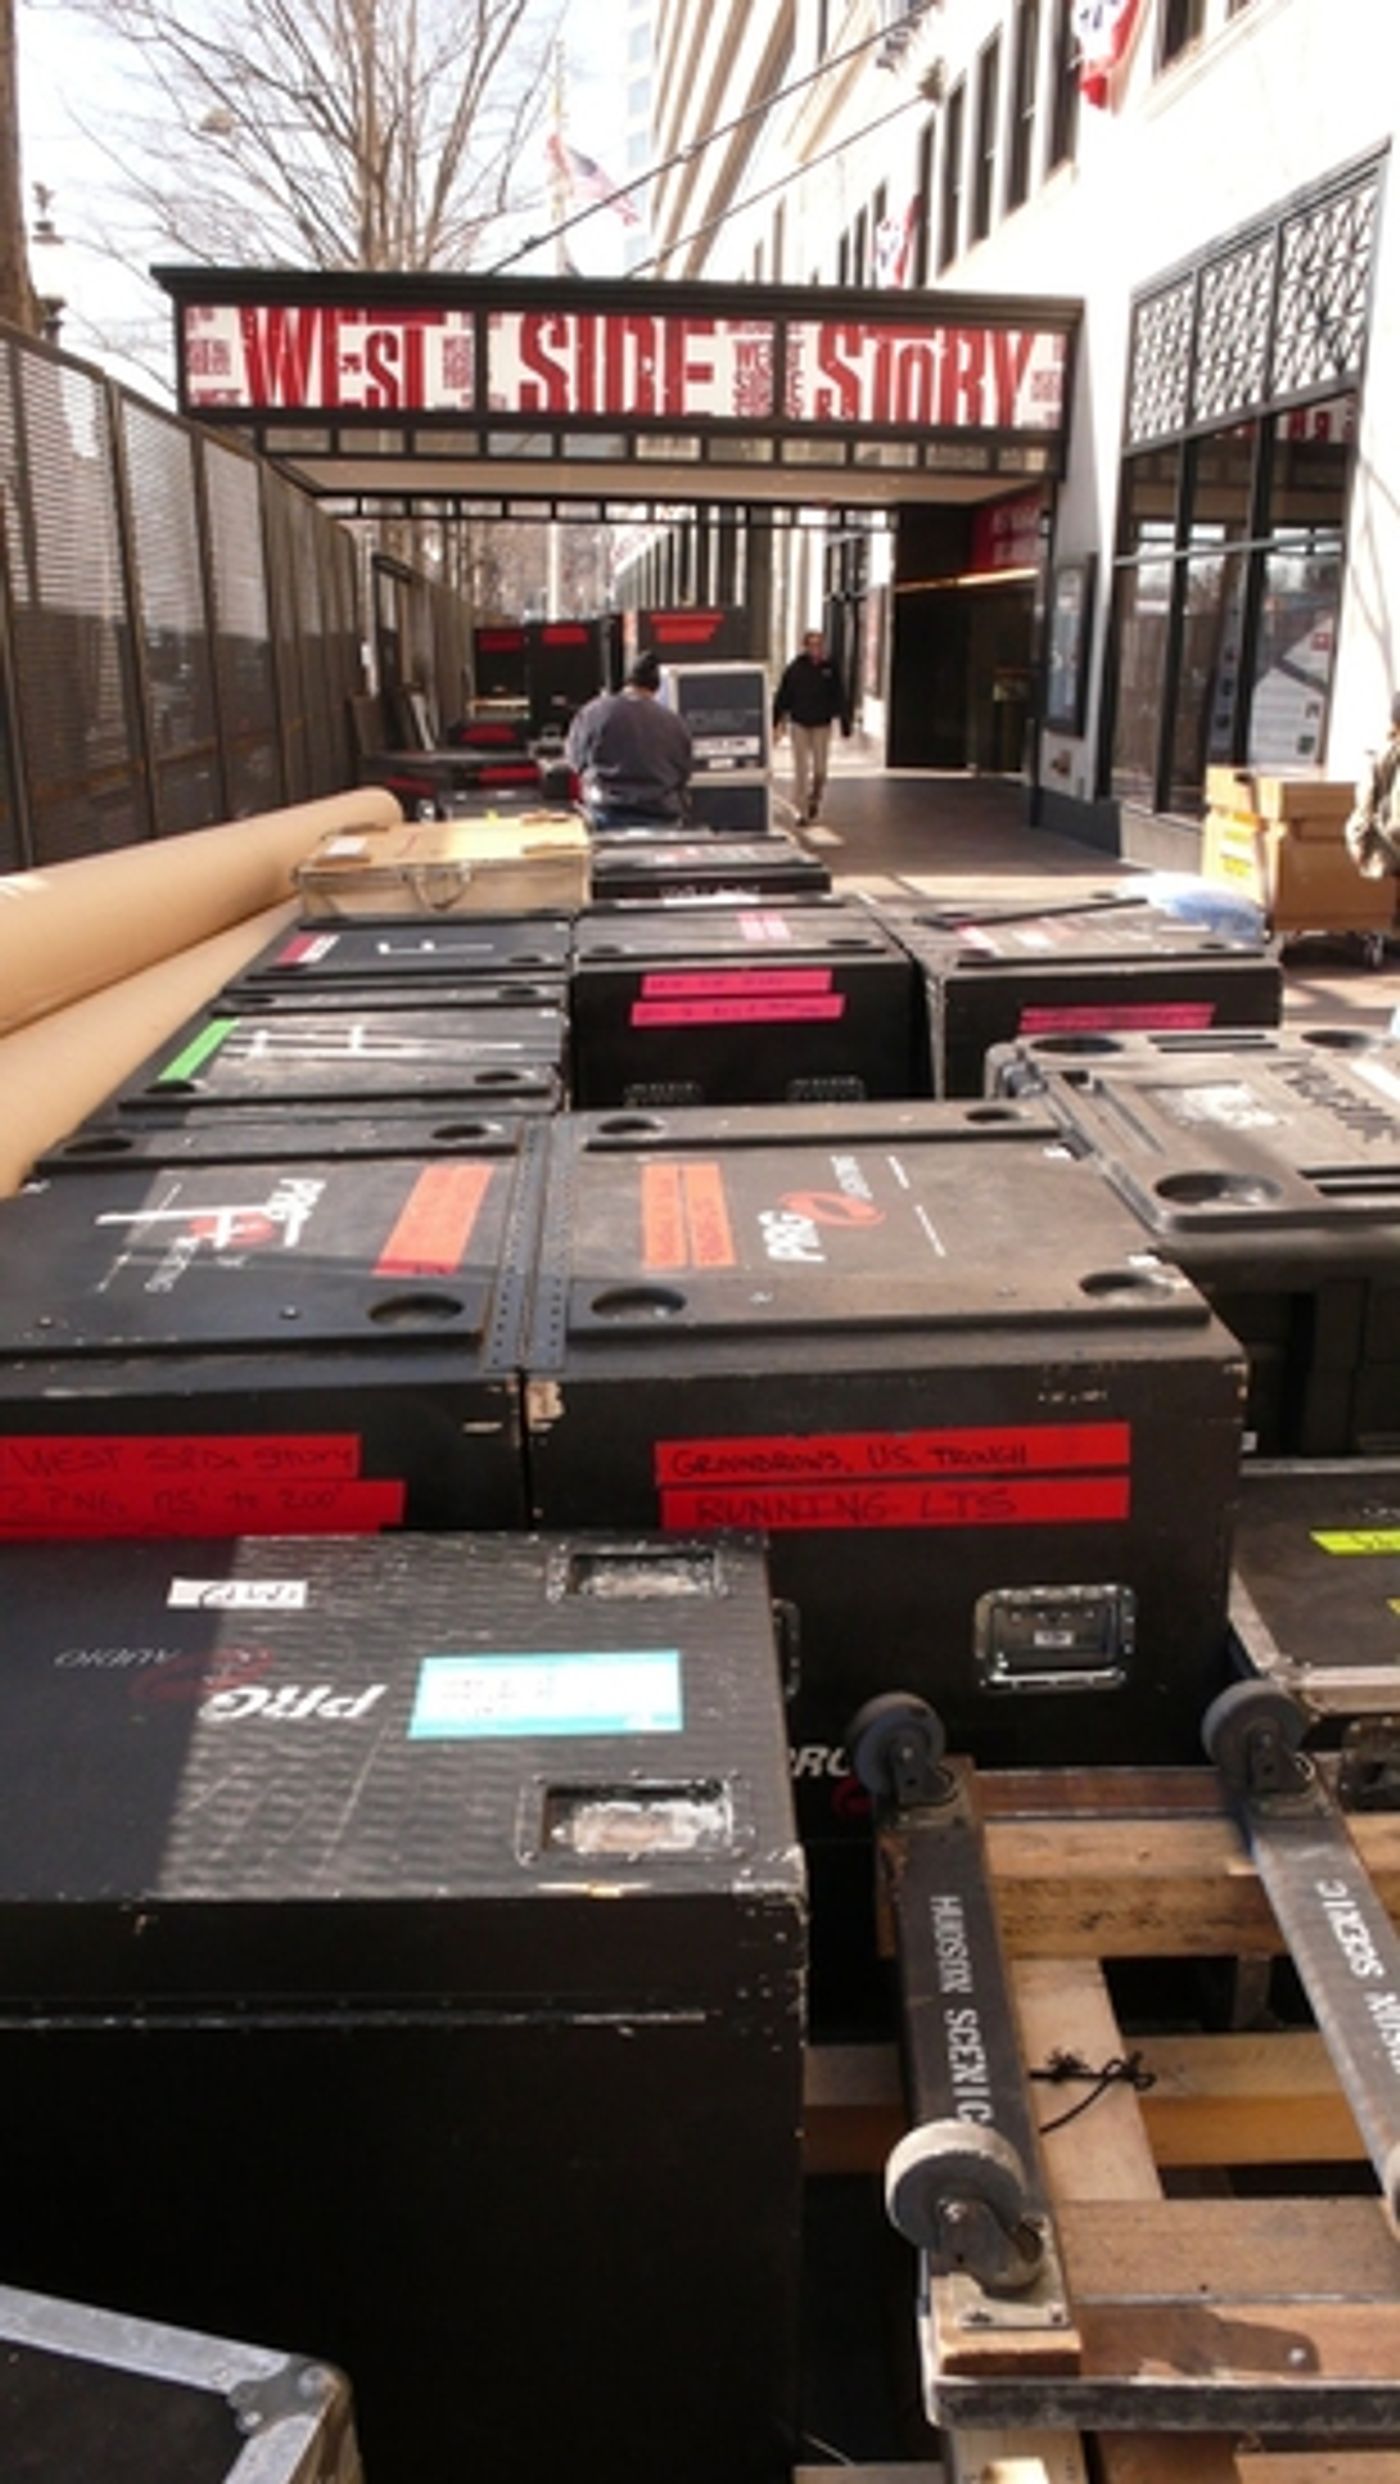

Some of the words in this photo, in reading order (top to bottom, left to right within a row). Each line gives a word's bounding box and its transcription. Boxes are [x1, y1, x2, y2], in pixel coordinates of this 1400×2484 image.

[240, 305, 447, 408] WEST
[519, 312, 716, 417] SIDE
[814, 322, 1033, 427] STORY
[920, 1487, 1018, 1519] LTS
[200, 1684, 388, 1722] PRG
[930, 1896, 973, 1995] HUDSON
[1317, 1880, 1385, 1979] SCENIC
[945, 2007, 993, 2128] SCENIC
